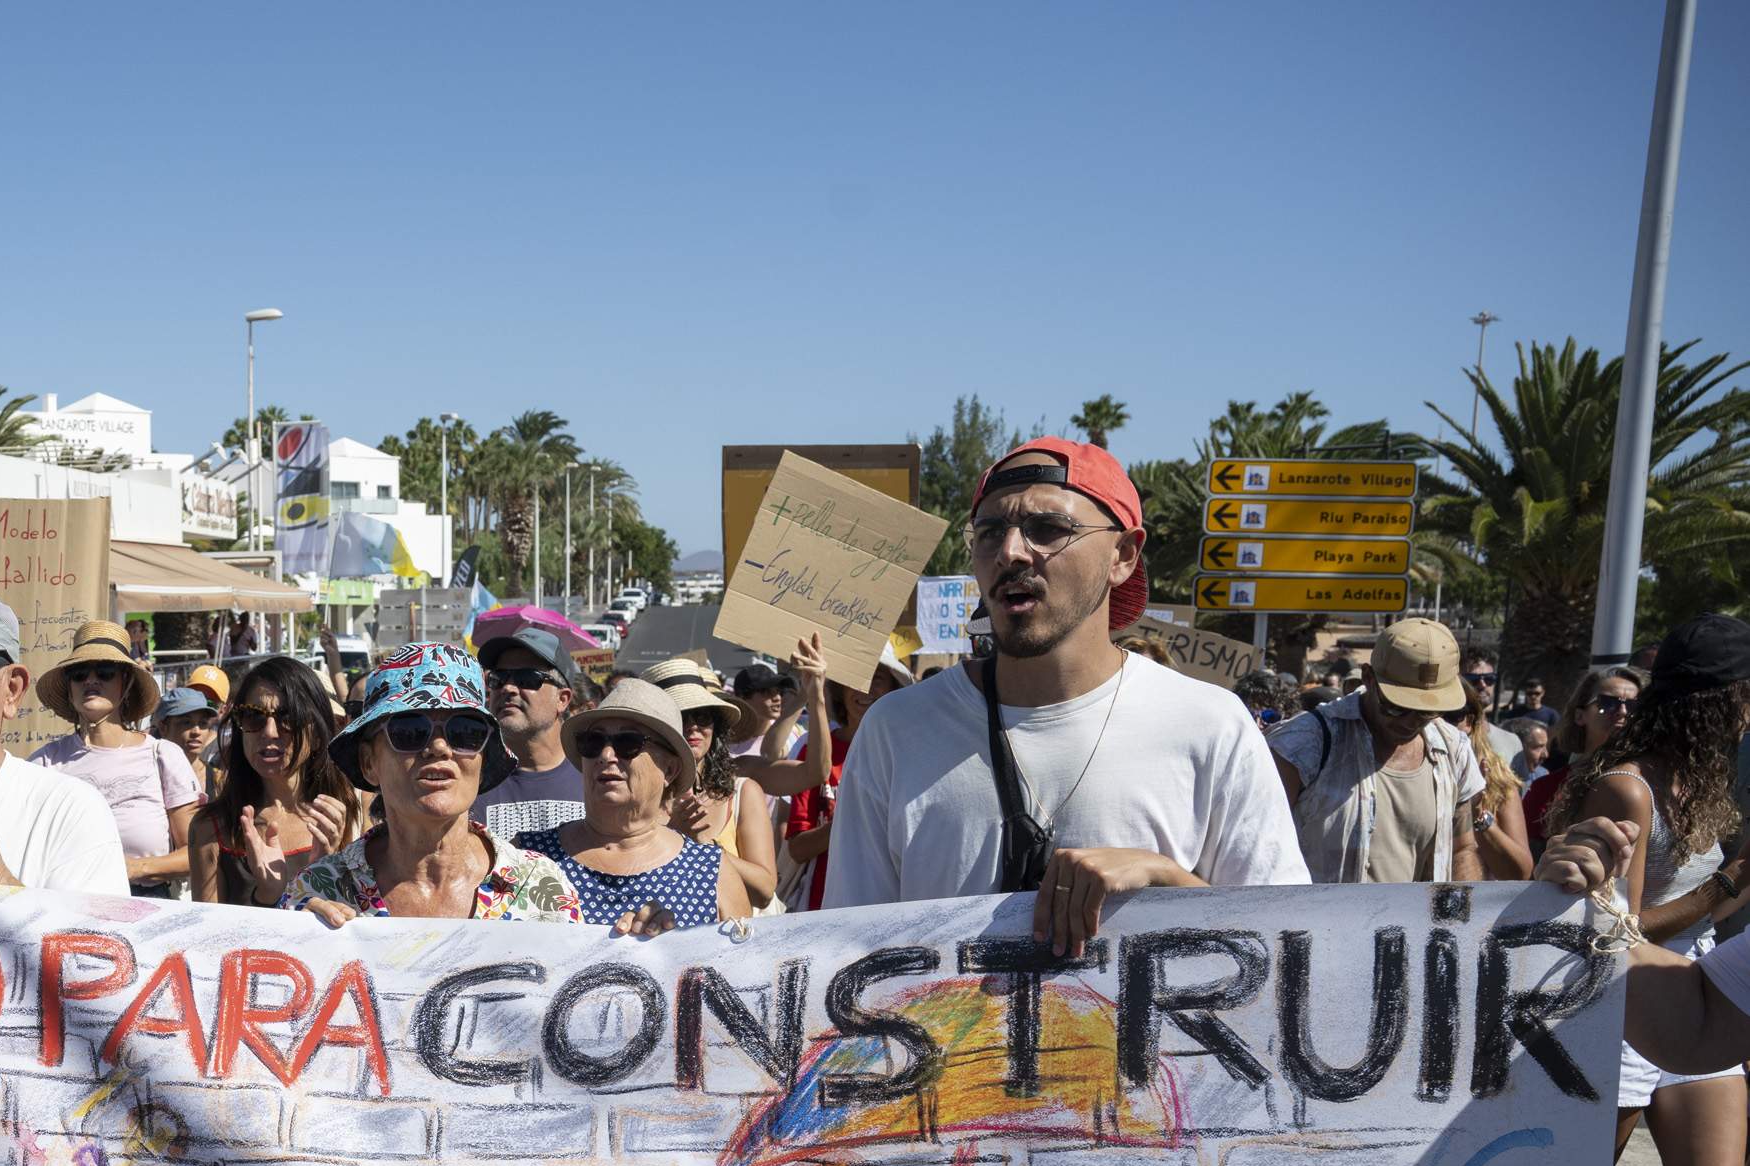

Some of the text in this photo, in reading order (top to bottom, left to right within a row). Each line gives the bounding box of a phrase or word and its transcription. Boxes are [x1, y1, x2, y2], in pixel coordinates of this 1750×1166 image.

[41, 416, 135, 434] LANZAROTE VILLAGE
[1278, 473, 1412, 488] Lanzarote Village
[1319, 512, 1408, 525] Riu Paraiso
[1314, 551, 1397, 564] Playa Park
[762, 549, 818, 606] English
[820, 578, 883, 638] breakfast
[1306, 589, 1402, 601] Las Adelfas
[38, 928, 393, 1098] PARA
